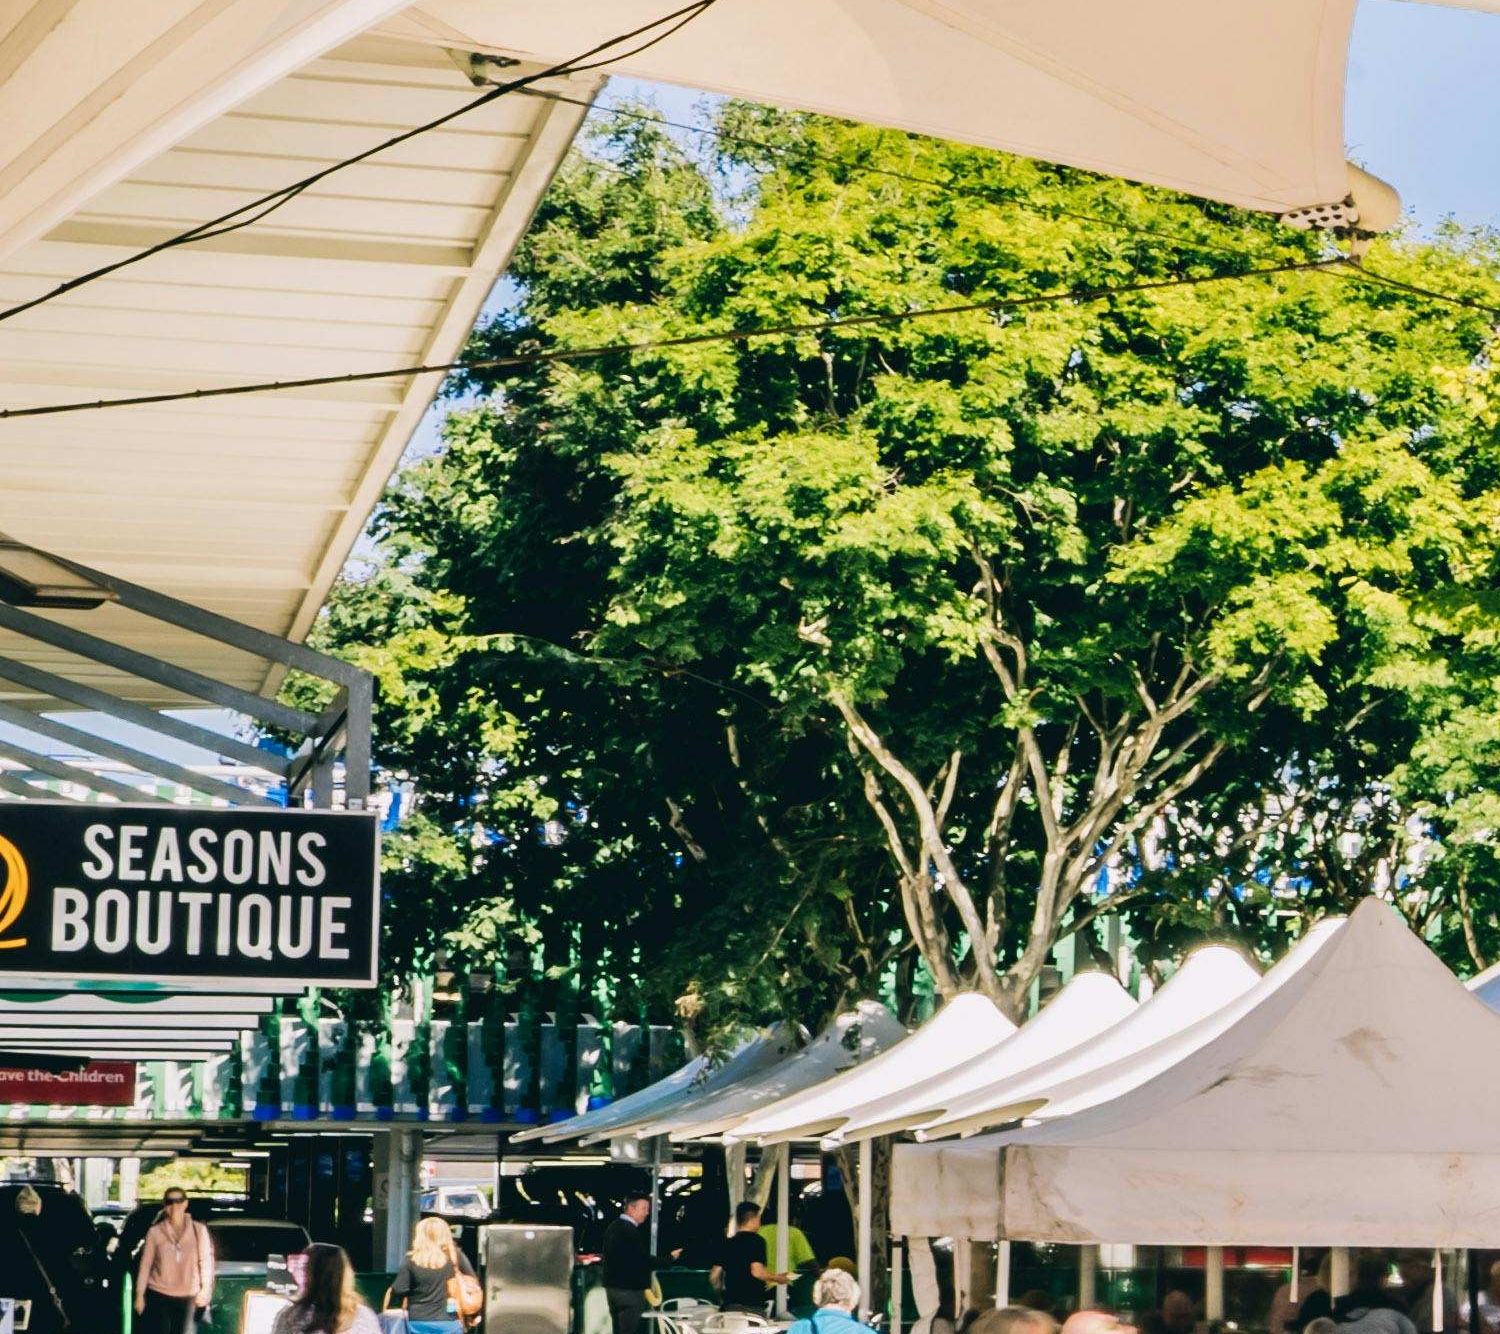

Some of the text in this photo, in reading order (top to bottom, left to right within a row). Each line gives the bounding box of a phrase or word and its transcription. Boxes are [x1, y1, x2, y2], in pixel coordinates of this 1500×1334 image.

[81, 824, 326, 887] SEASONS
[51, 887, 351, 961] BOUTIQUE
[0, 1070, 24, 1082] ave
[27, 1069, 54, 1082] the
